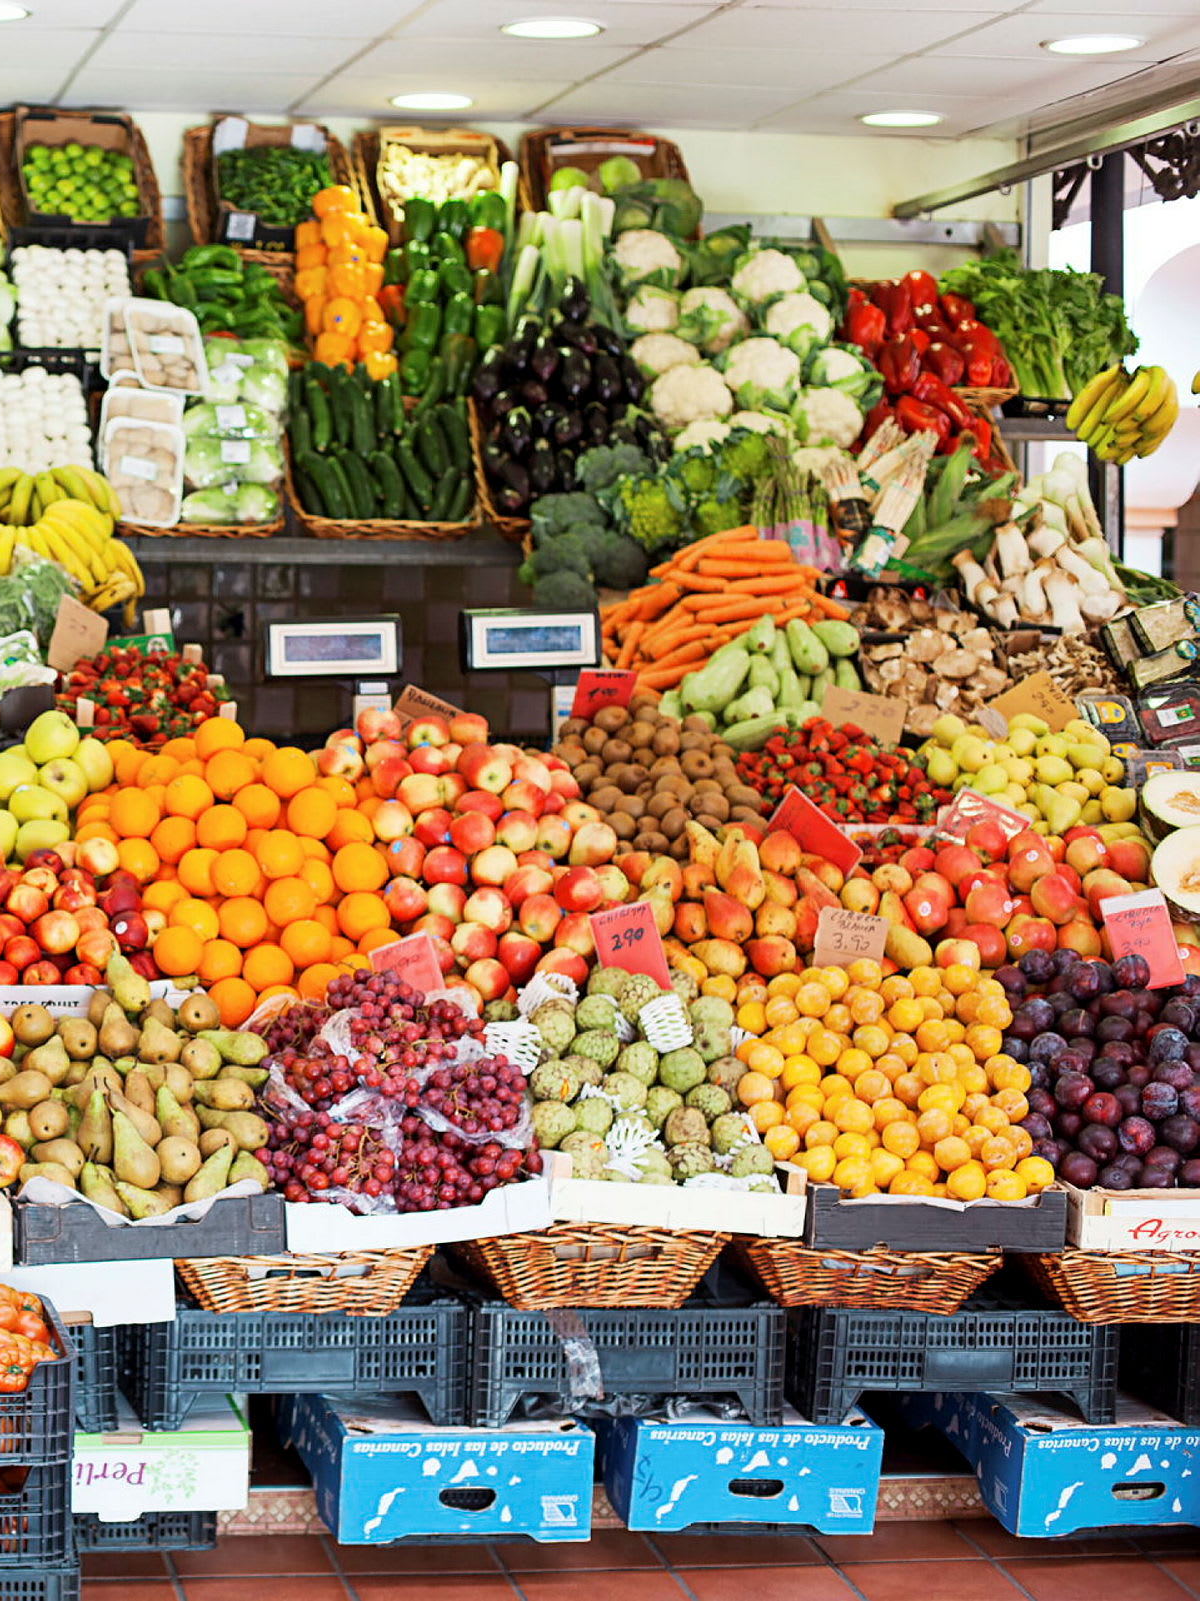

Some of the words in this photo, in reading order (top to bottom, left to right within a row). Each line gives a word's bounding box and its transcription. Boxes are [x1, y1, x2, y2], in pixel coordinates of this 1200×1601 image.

[1127, 1218, 1200, 1244] Agro
[650, 1430, 717, 1447] Canarias
[720, 1431, 756, 1447] Islas
[757, 1432, 780, 1448] las
[782, 1433, 803, 1449] de
[804, 1434, 871, 1451] Producto
[1037, 1437, 1101, 1453] Canarias
[1104, 1436, 1138, 1451] Islas
[1140, 1436, 1162, 1451] las
[1164, 1436, 1184, 1451] de
[353, 1442, 422, 1458] Canarias
[426, 1441, 462, 1458] Islas
[463, 1441, 488, 1457] las
[489, 1441, 510, 1457] de
[512, 1440, 581, 1457] Producto
